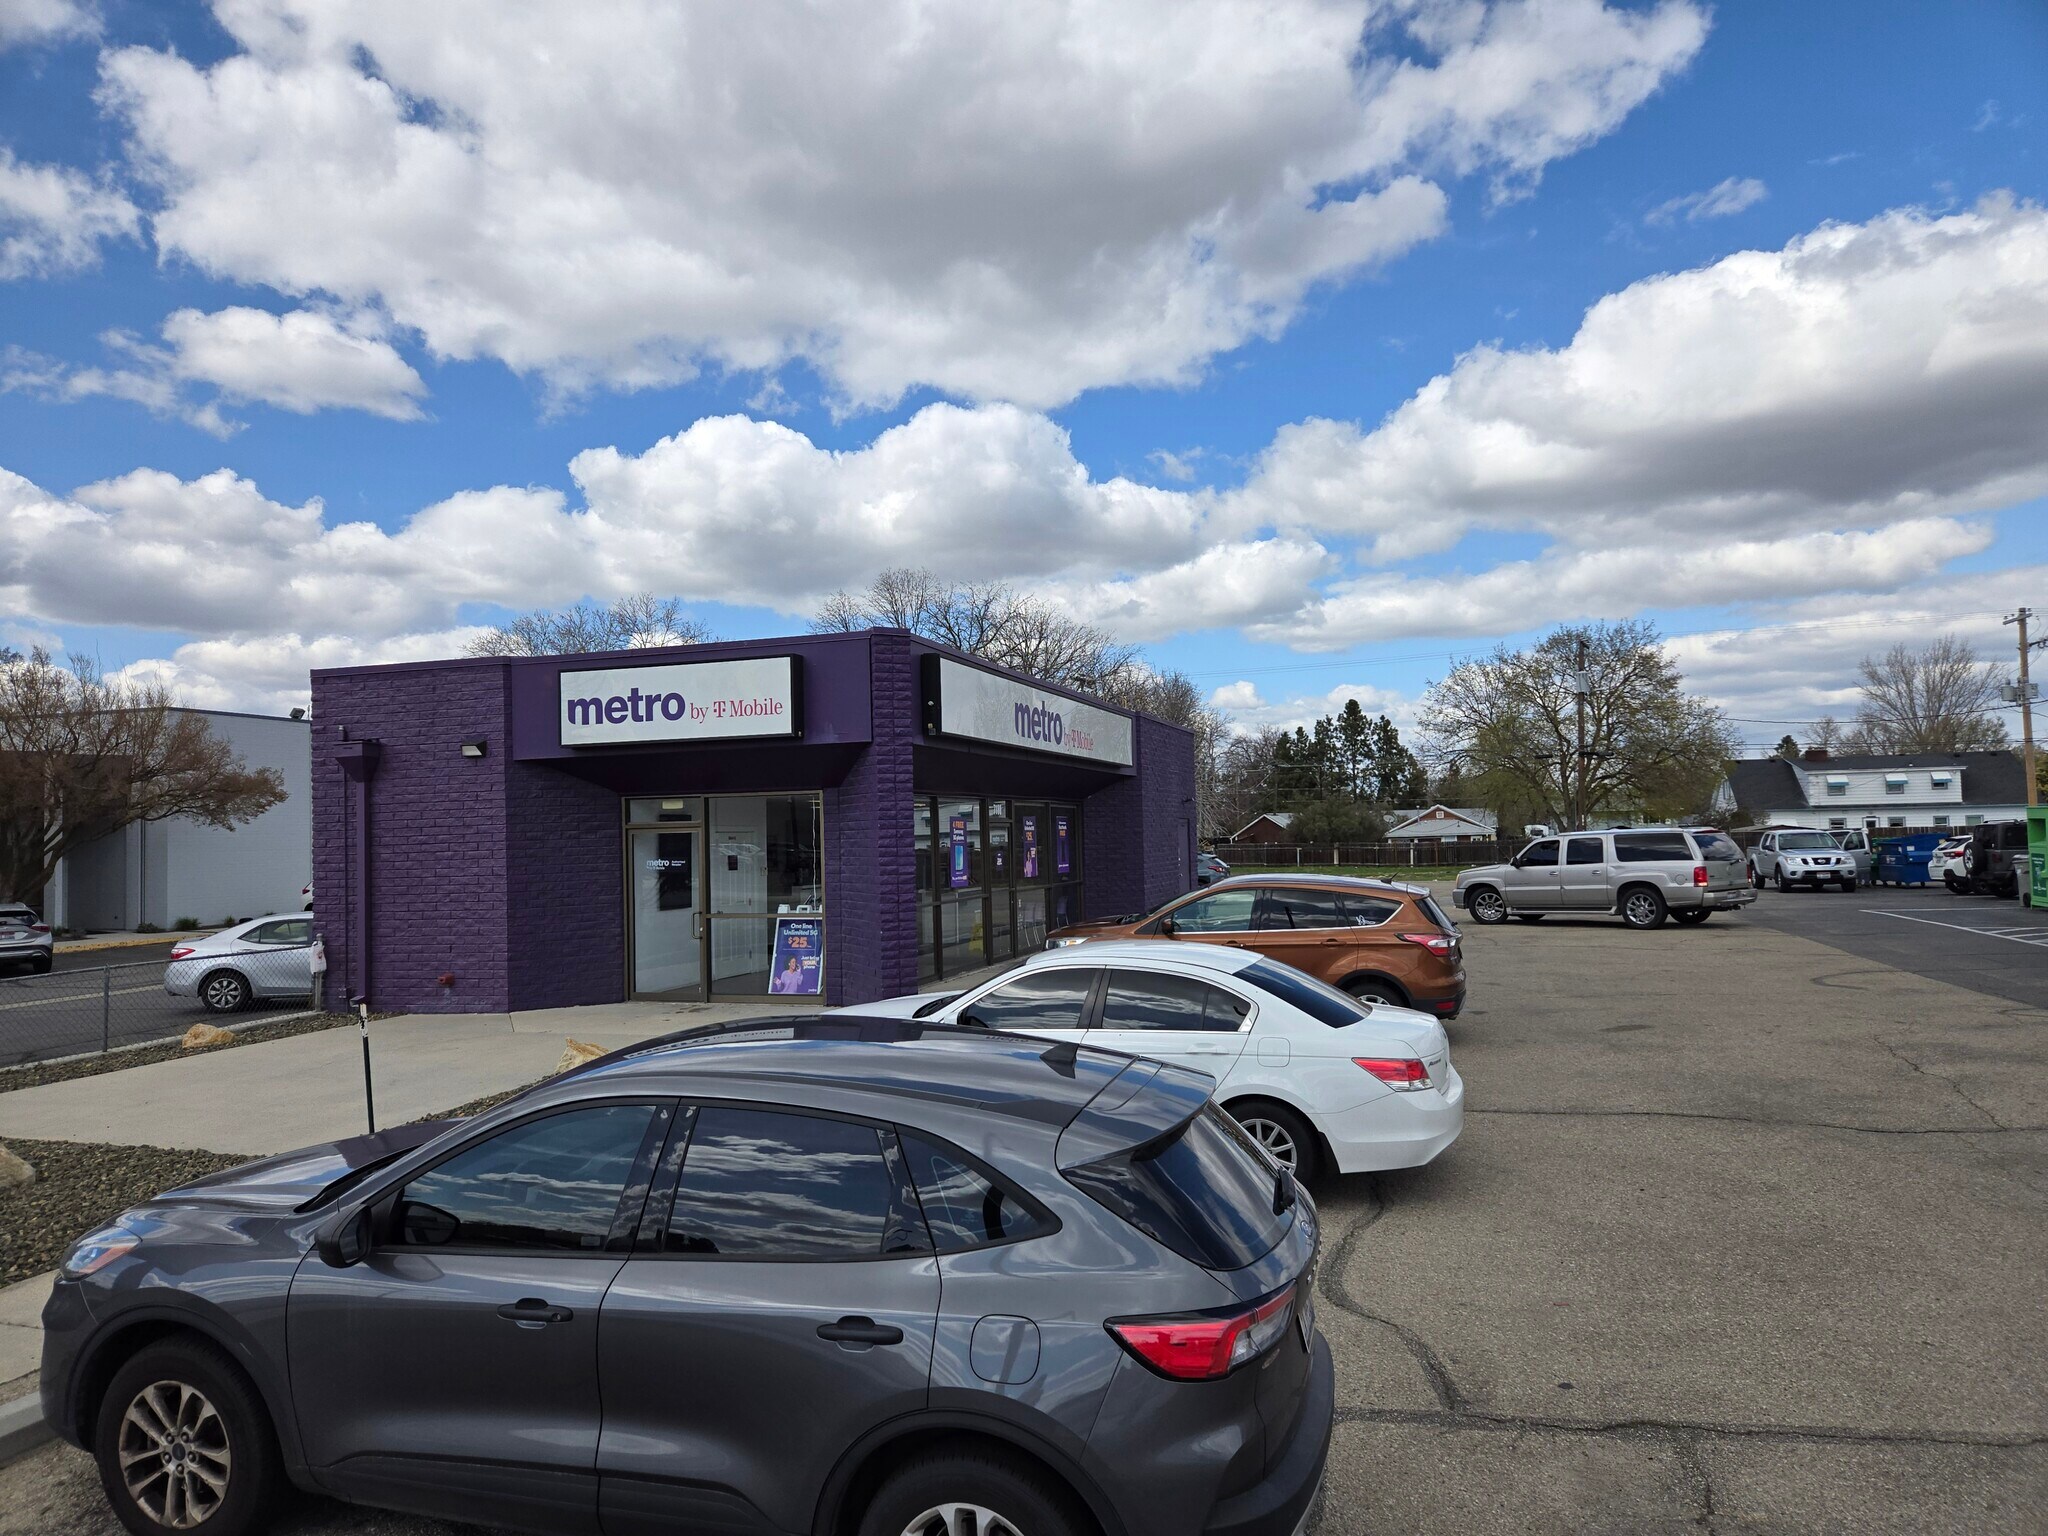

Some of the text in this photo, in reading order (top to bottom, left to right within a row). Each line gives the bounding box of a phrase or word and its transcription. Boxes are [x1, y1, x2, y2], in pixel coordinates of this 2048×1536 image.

[567, 687, 783, 726] metro by T Mobile
[1015, 701, 1062, 745] metro
[1064, 727, 1071, 751] by
[788, 936, 808, 948] $25
